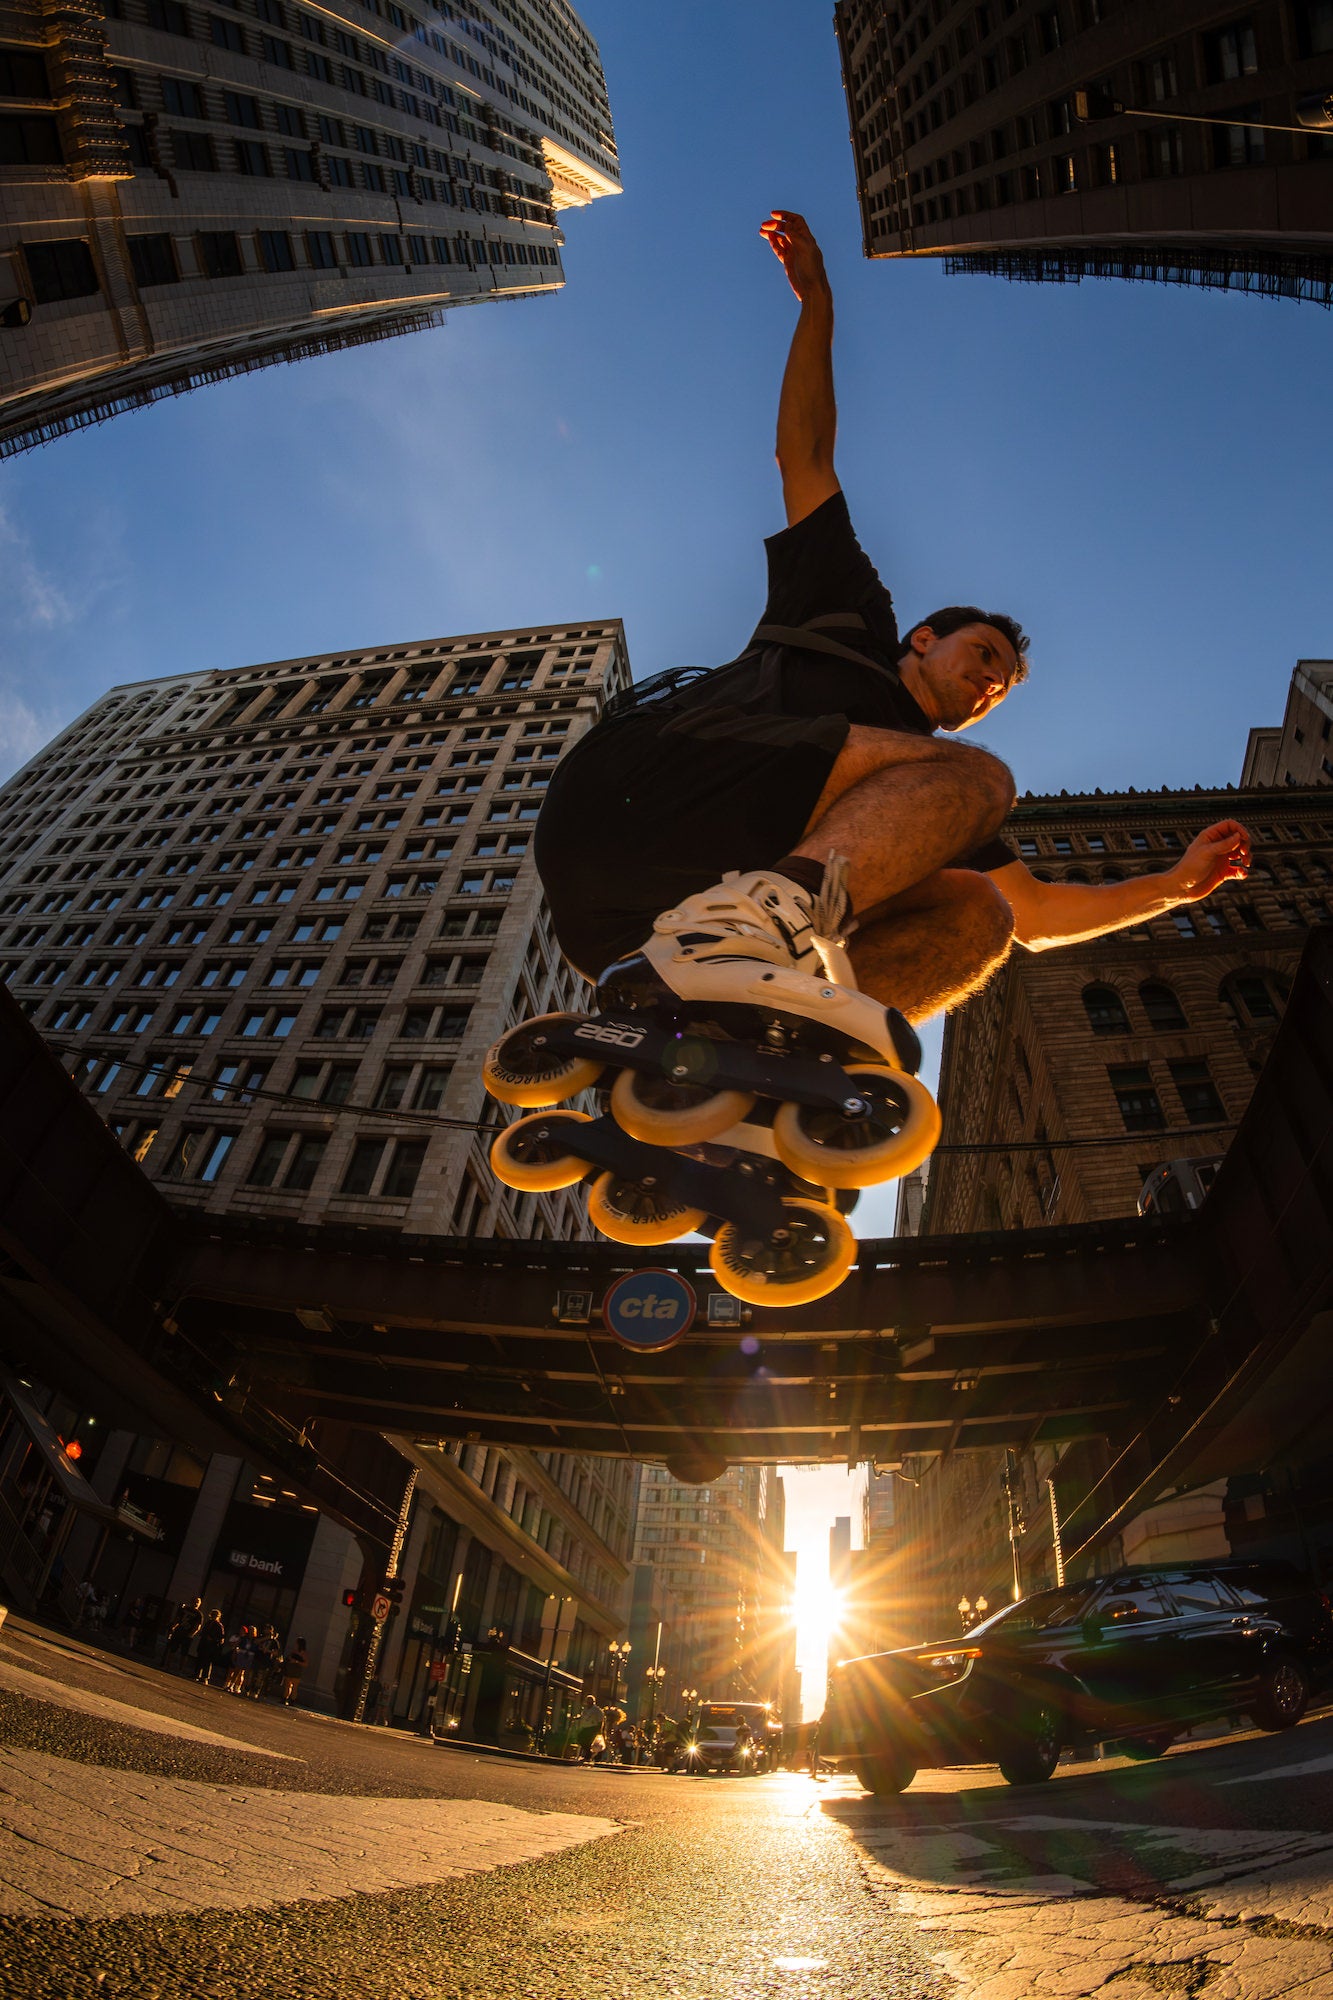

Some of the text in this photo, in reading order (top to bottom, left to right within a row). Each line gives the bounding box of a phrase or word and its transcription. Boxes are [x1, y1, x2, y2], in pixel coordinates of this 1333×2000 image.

[573, 1022, 645, 1048] 260
[490, 1057, 575, 1085] UNDERCOVER
[632, 1204, 687, 1224] RCOVER
[619, 1294, 679, 1319] cta
[231, 1552, 283, 1575] us bank
